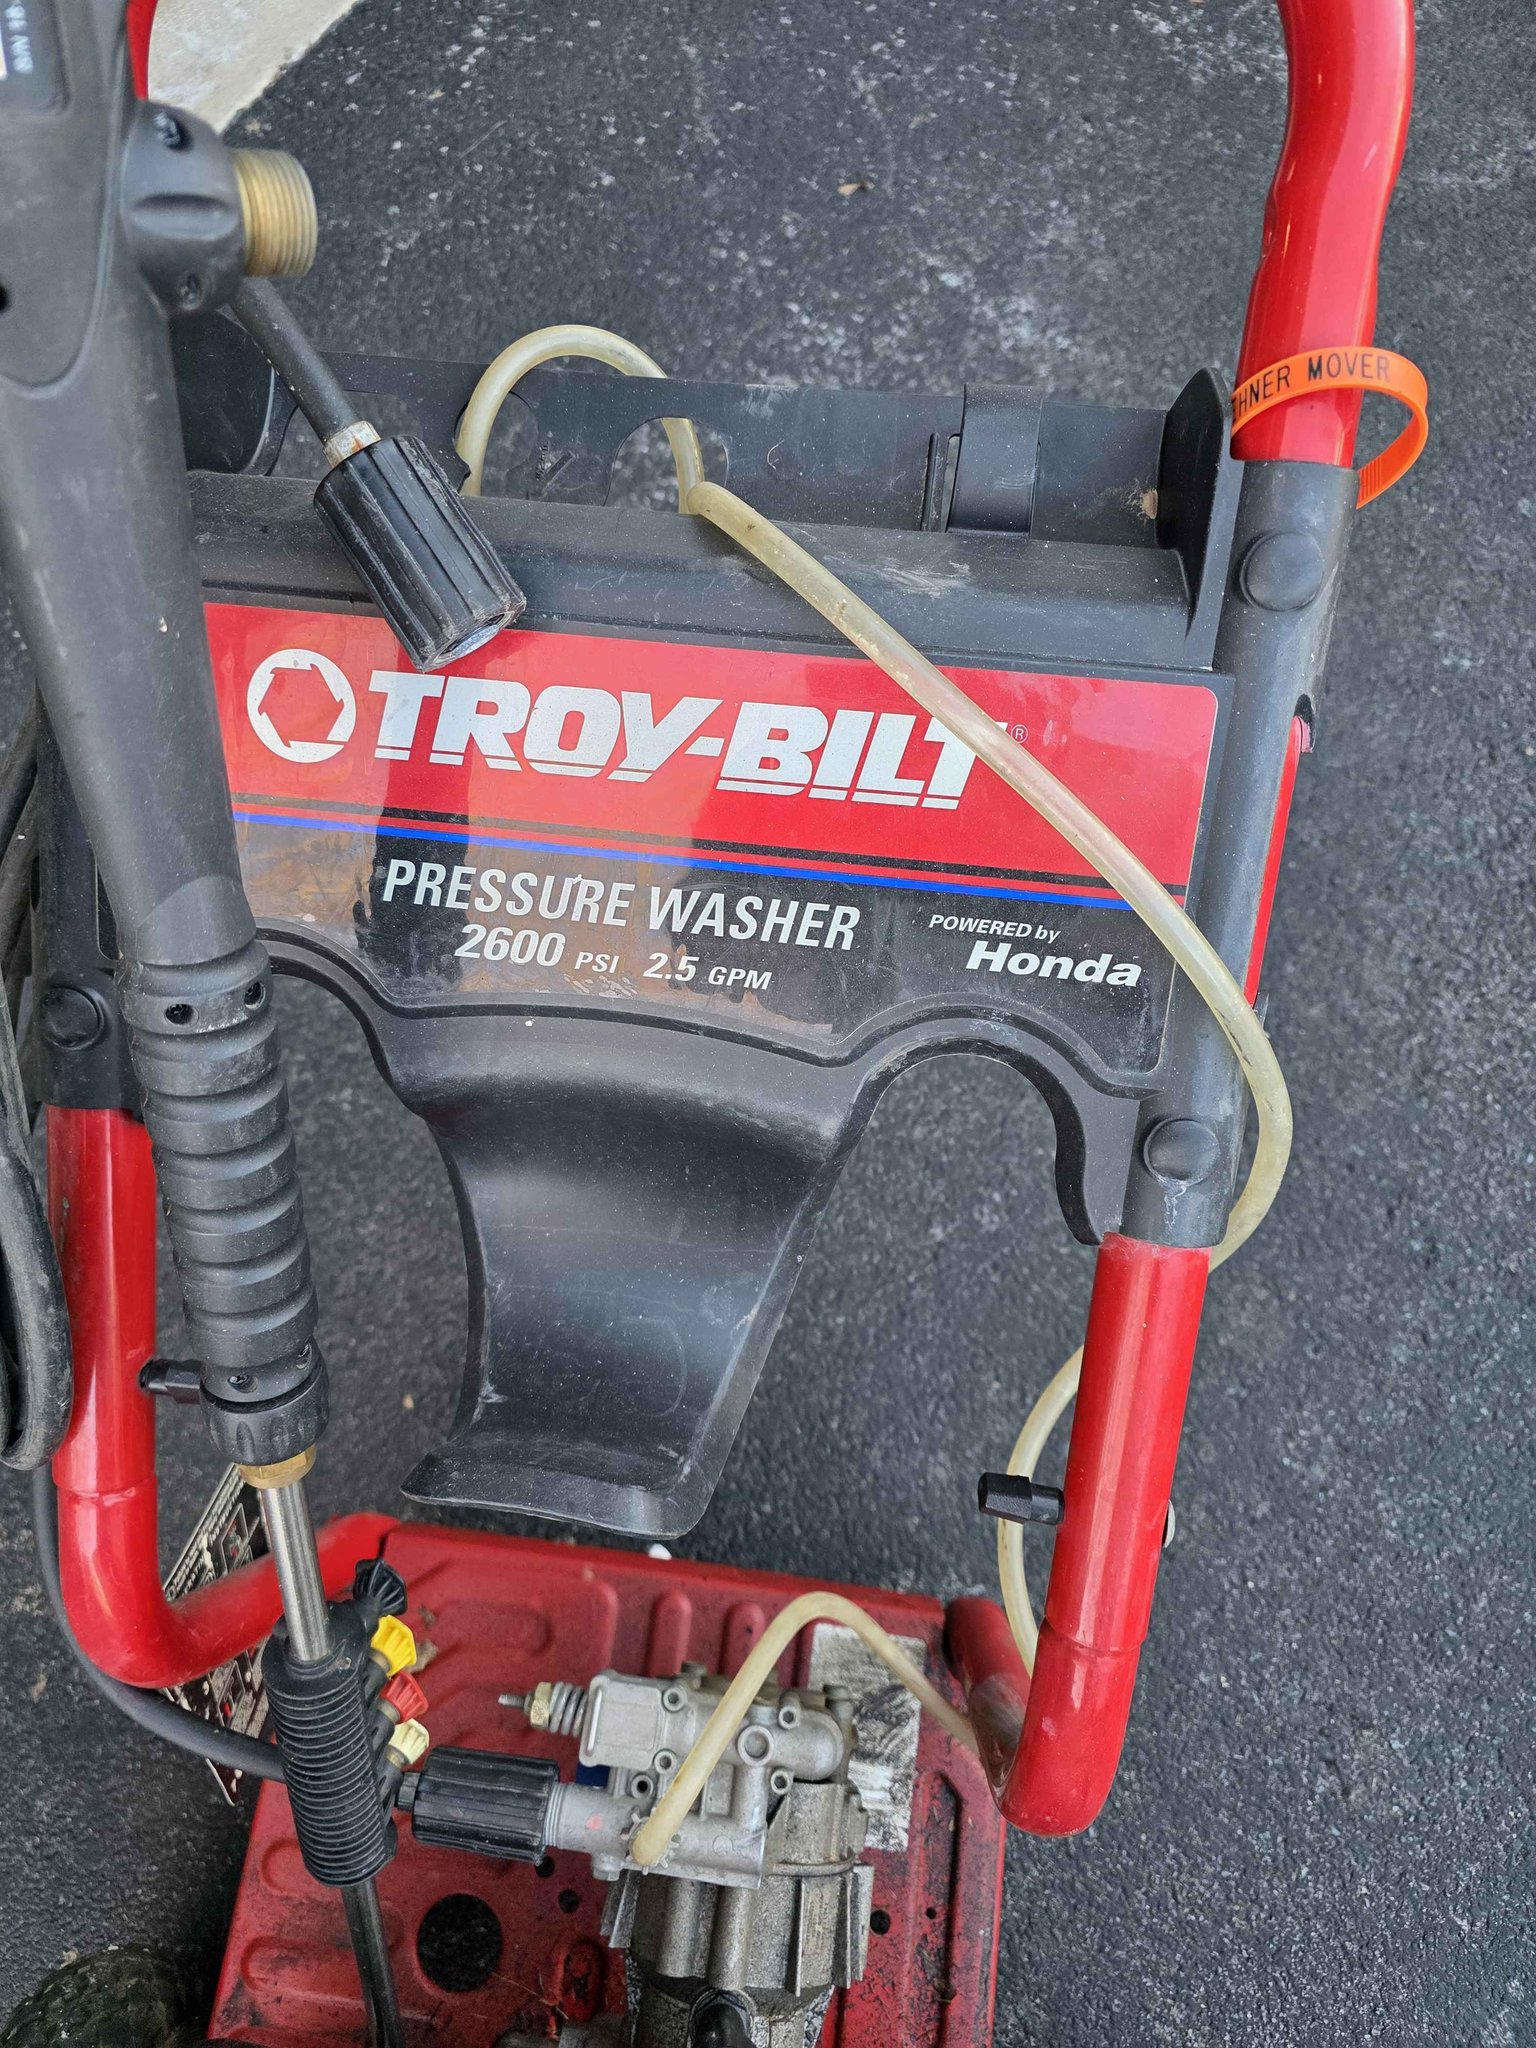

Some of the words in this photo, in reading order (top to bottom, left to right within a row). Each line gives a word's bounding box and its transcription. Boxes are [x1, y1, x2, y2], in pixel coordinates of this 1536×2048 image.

[1308, 352, 1391, 383] MOVER
[368, 670, 1008, 810] TROY-BILT
[382, 858, 636, 928] PRESSURE
[647, 886, 861, 951] WASHER
[928, 914, 1032, 939] POWERED
[1034, 925, 1061, 944] by
[454, 923, 567, 967] 2600
[573, 952, 620, 975] PSI
[642, 952, 700, 982] 2.5
[707, 966, 773, 991] GPM
[965, 940, 1142, 988] Honda
